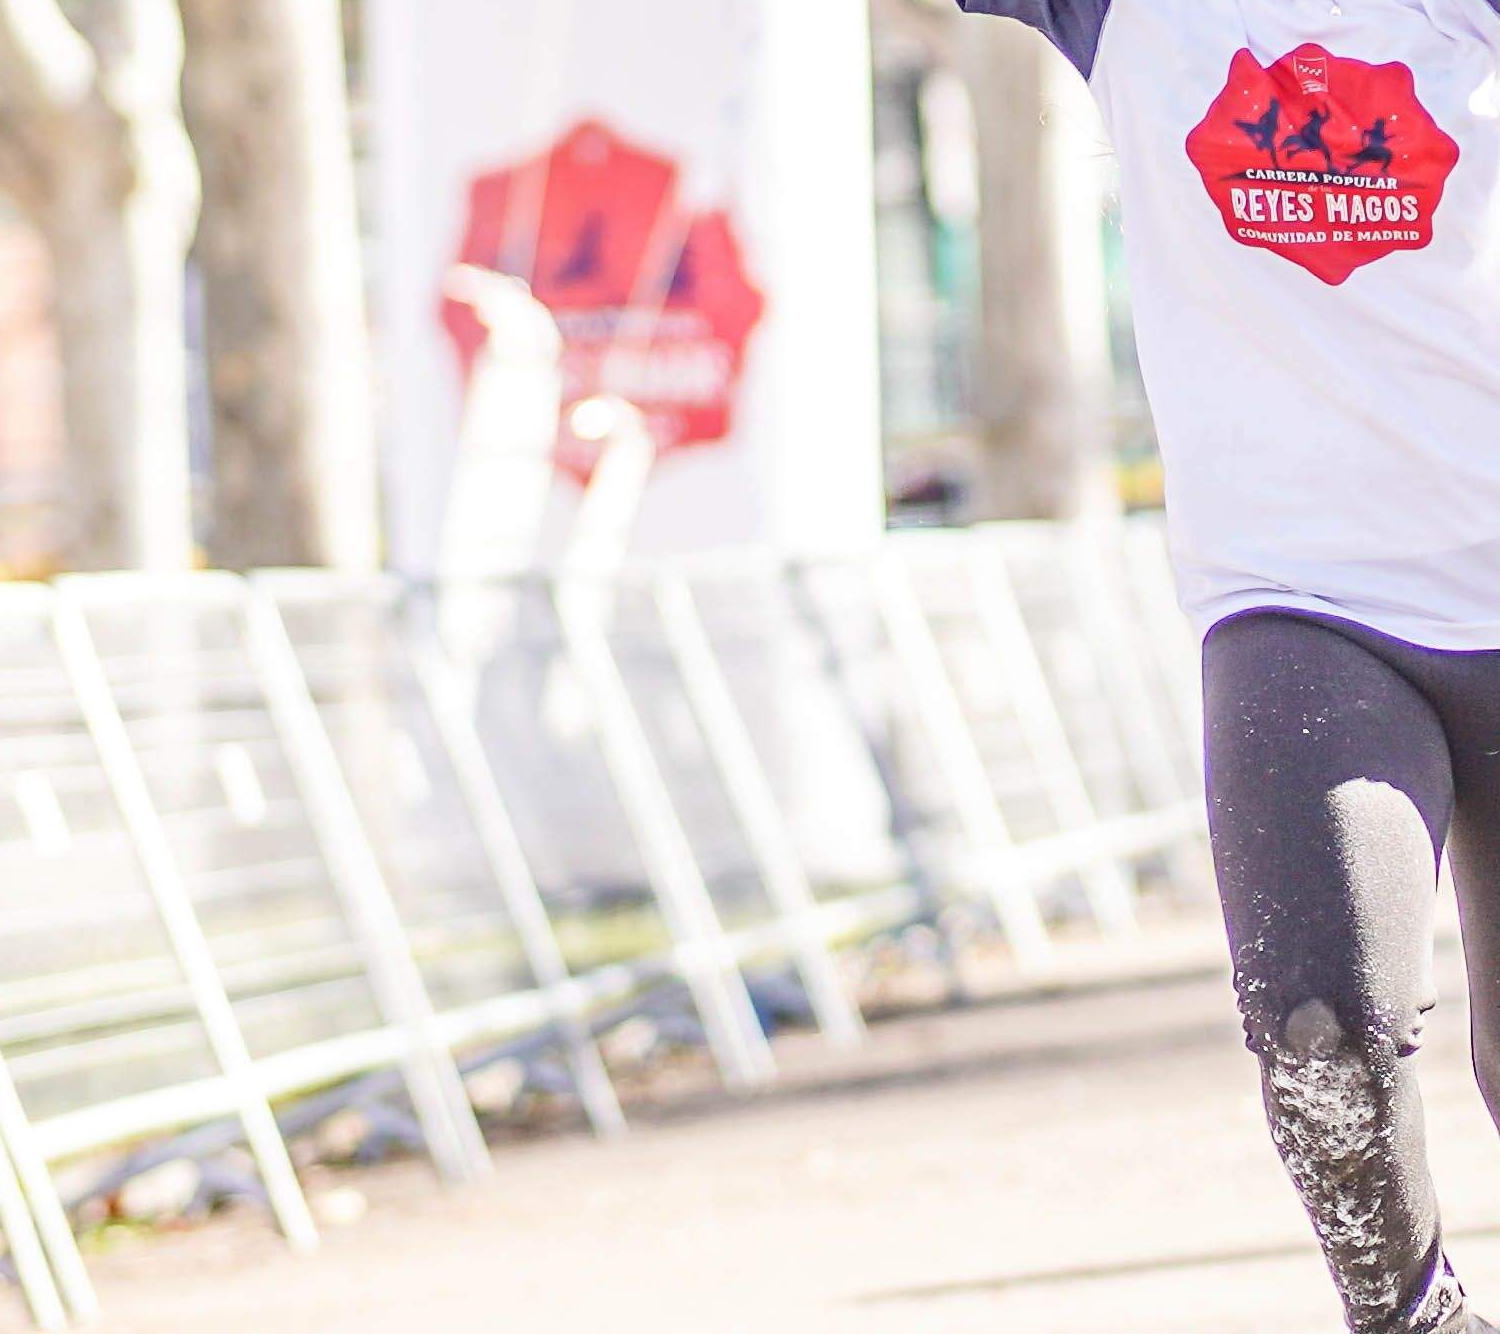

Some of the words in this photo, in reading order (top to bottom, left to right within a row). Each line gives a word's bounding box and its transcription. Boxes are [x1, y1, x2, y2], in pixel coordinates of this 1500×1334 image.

[1246, 169, 1318, 183] CARRERA
[1323, 173, 1398, 190] POPULAR
[1231, 188, 1315, 222] REYES
[1325, 193, 1419, 224] MAGOS
[1238, 227, 1327, 244] COMUNIDAD
[1332, 230, 1353, 242] DE
[1357, 230, 1420, 242] MADRID
